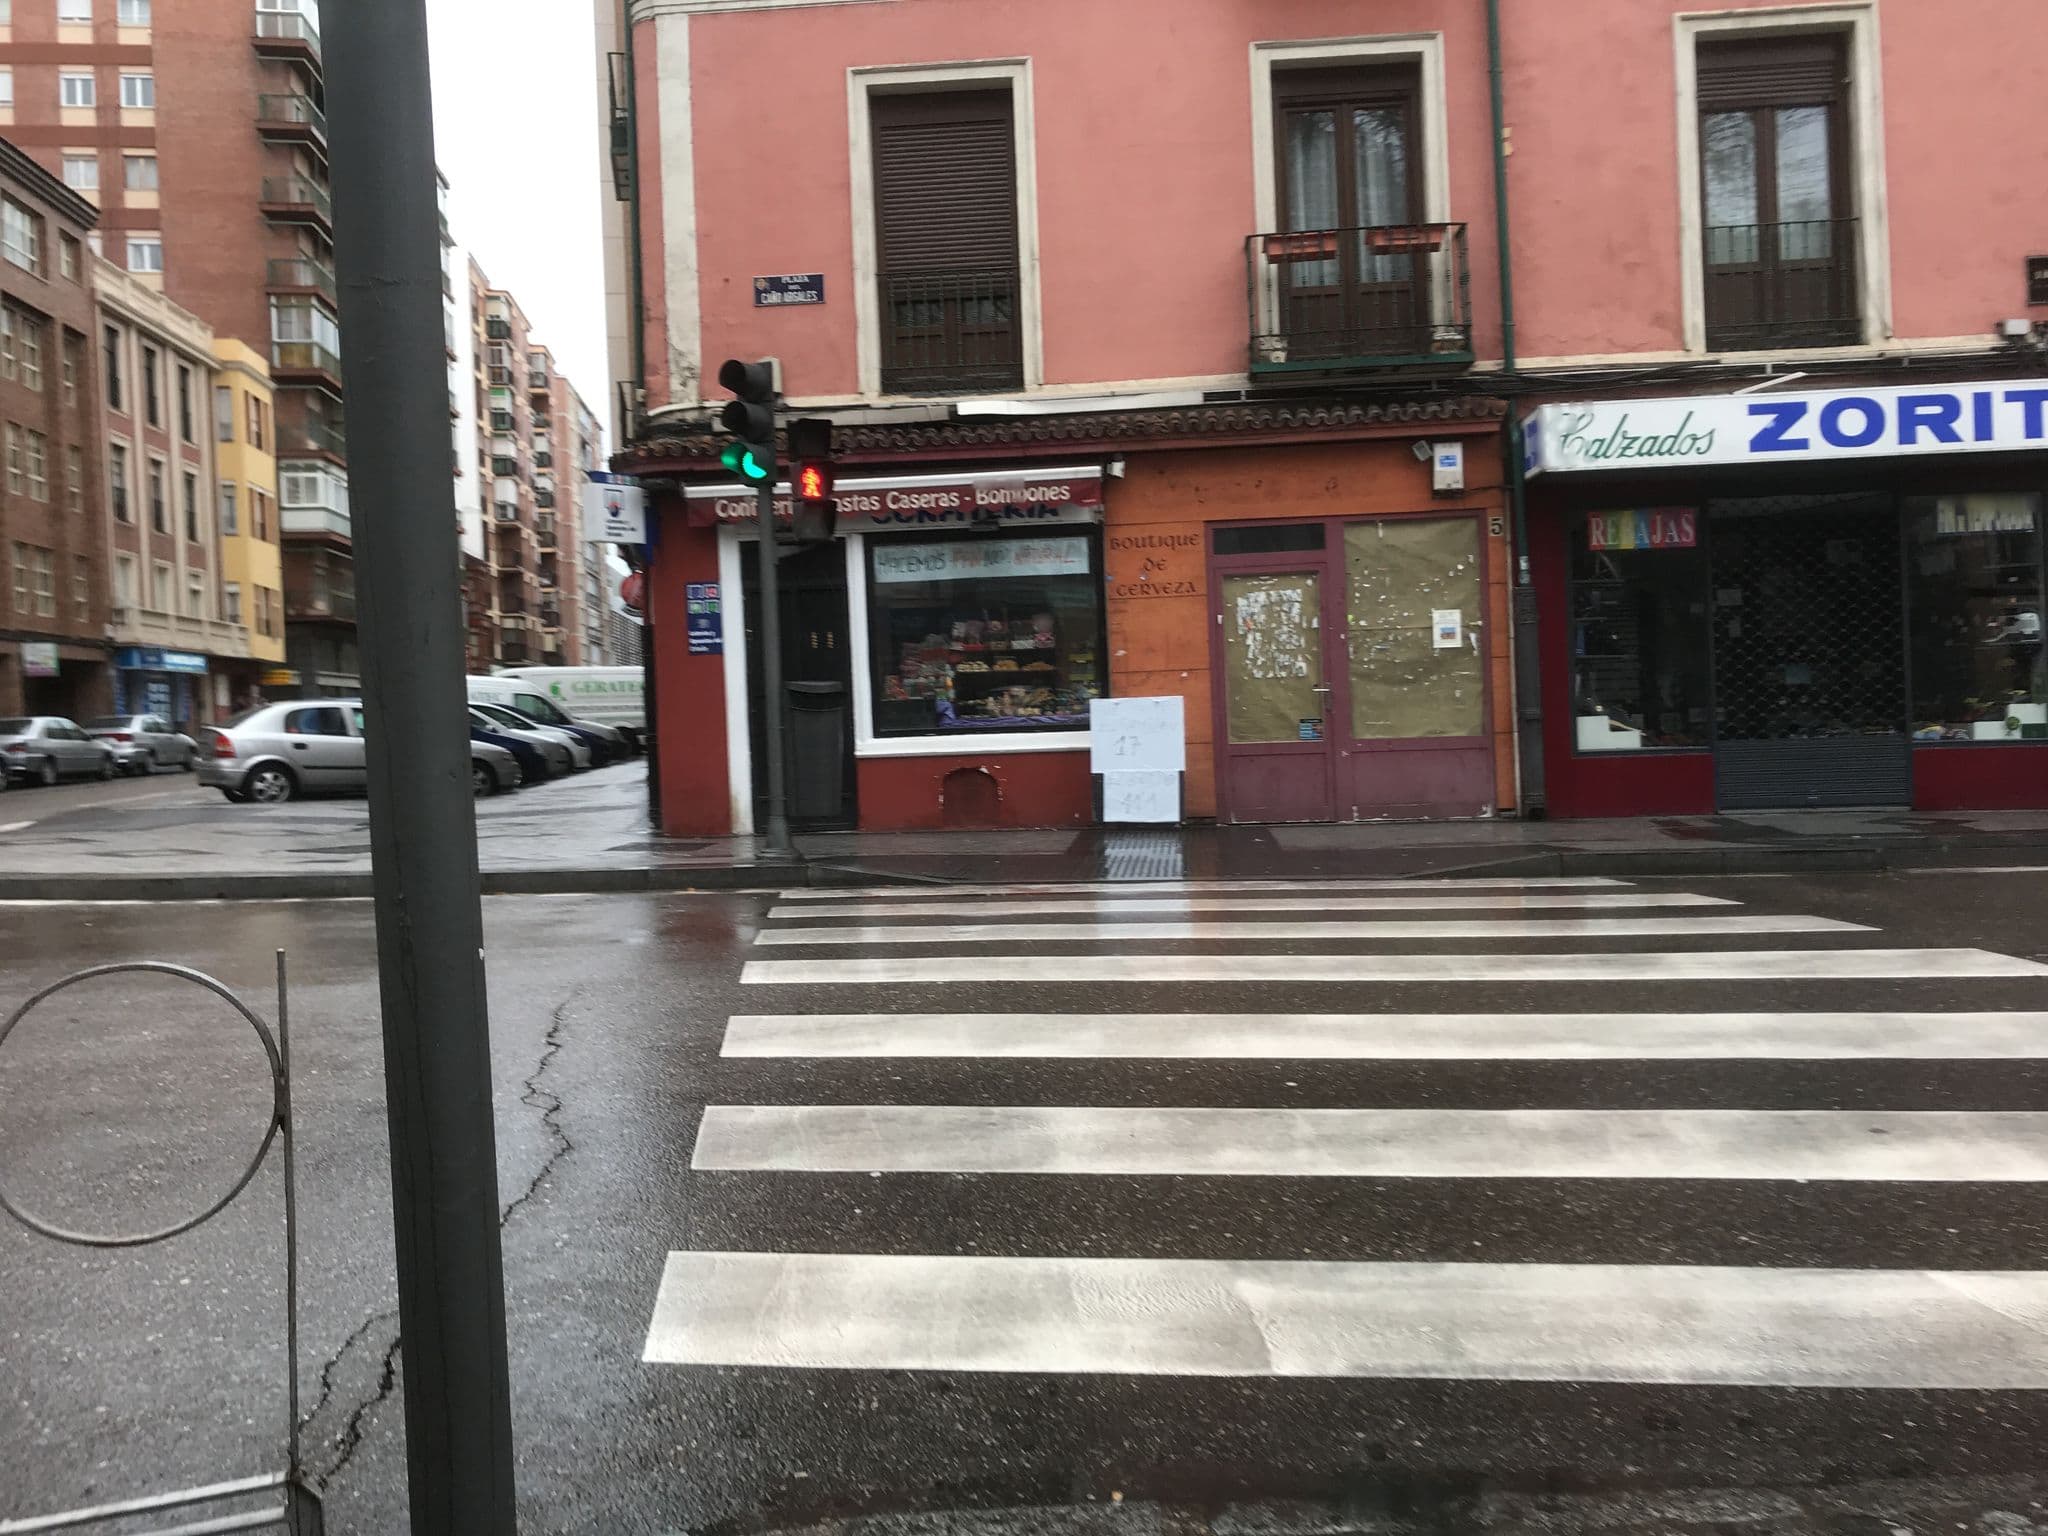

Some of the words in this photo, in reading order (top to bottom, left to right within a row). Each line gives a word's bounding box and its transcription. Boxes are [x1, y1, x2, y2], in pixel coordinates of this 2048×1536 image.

[1559, 410, 1717, 461] Calzados
[1747, 388, 2048, 454] ZORIT
[885, 490, 961, 510] Caseras
[1490, 517, 1503, 535] 5
[1590, 513, 1696, 546] REBAJAS
[1110, 533, 1200, 551] BOUTIQUE
[1143, 556, 1168, 572] DE
[1115, 581, 1197, 597] CERVEZA
